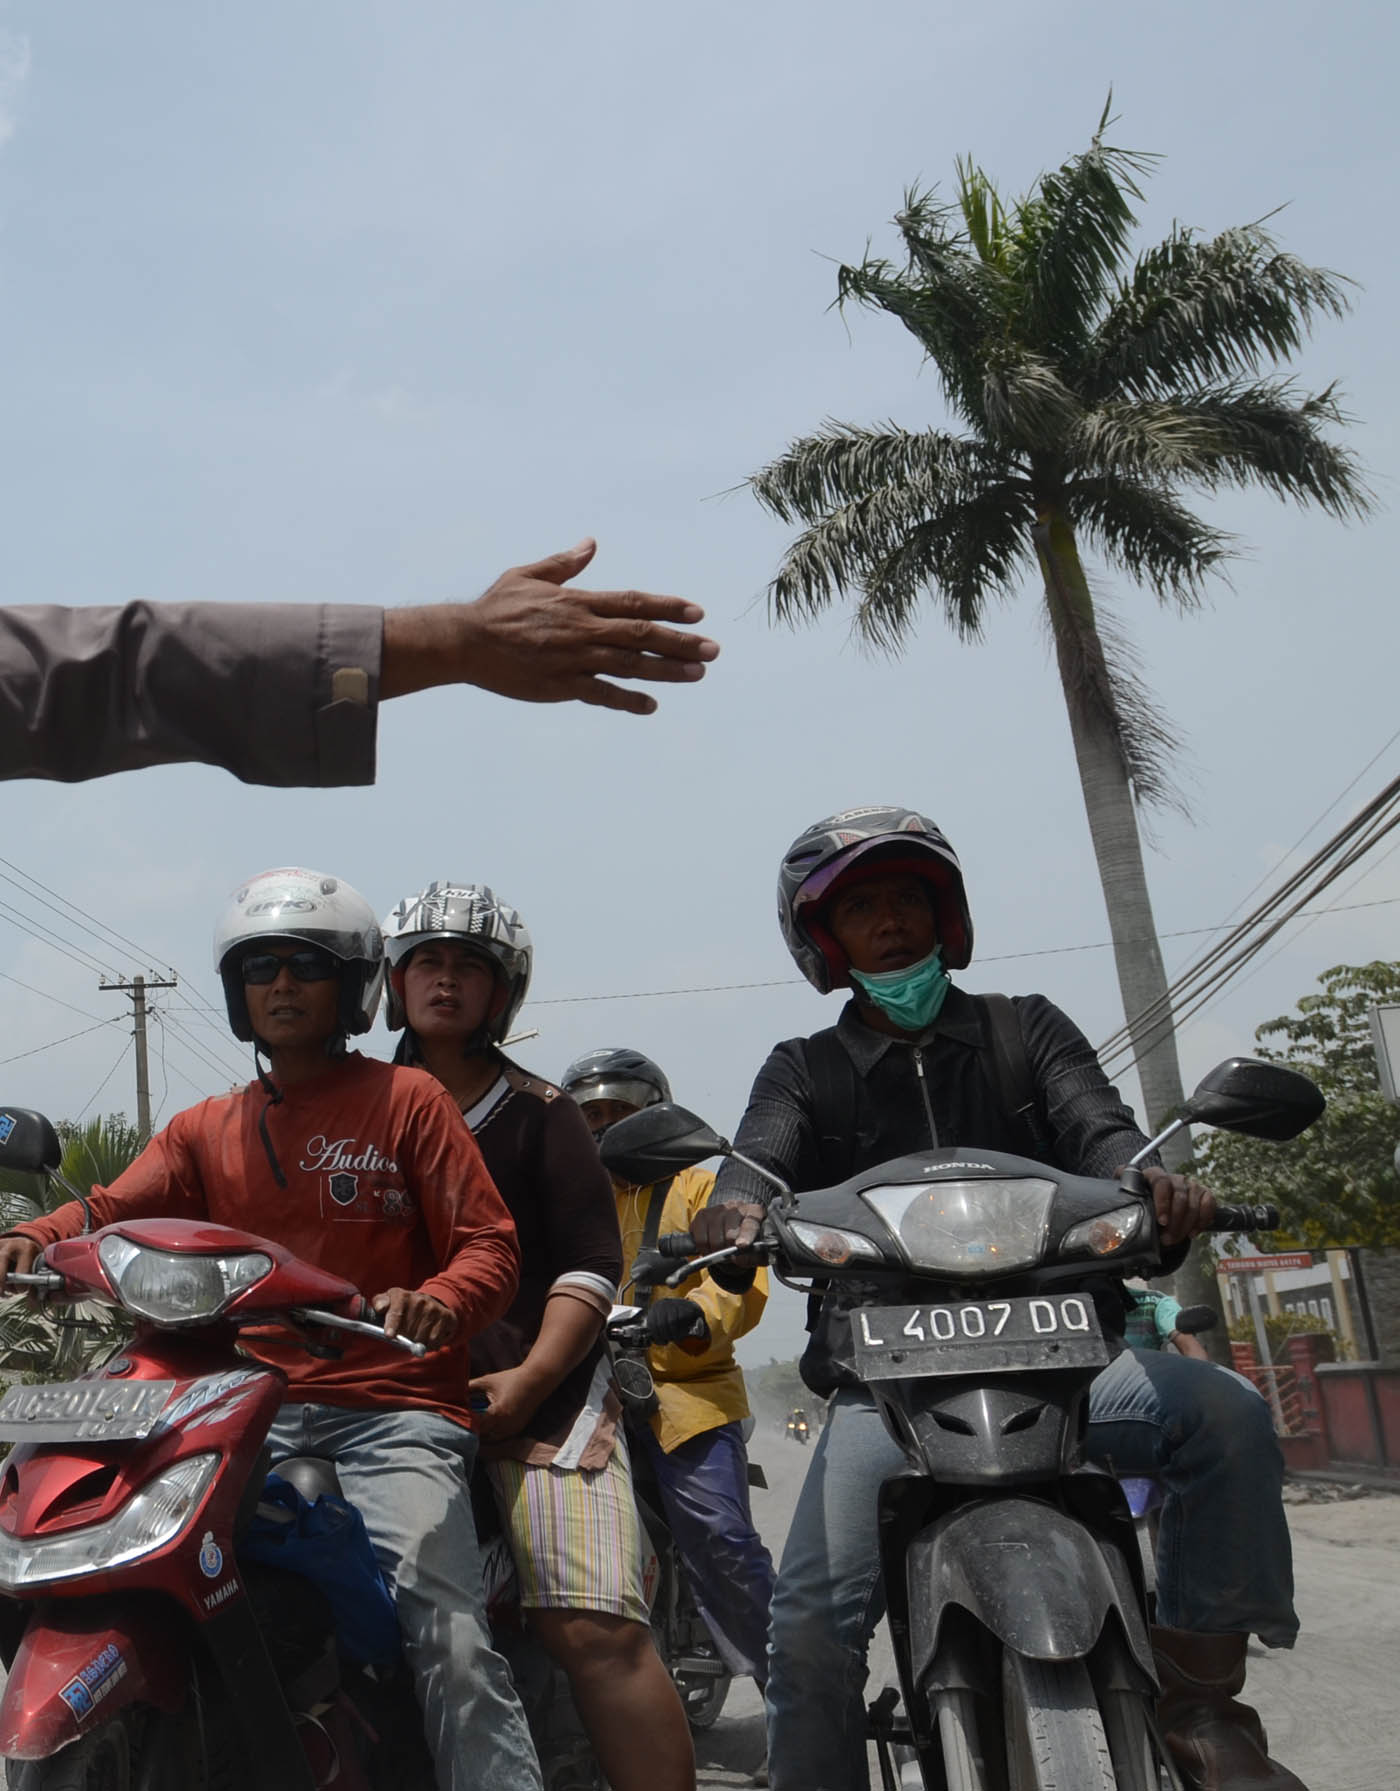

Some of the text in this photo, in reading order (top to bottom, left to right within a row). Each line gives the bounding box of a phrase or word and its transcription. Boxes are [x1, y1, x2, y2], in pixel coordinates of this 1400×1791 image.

[923, 1161, 996, 1174] HONDA
[860, 1298, 1090, 1346] L 4007 DQ
[203, 1578, 239, 1611] YAMAHA
